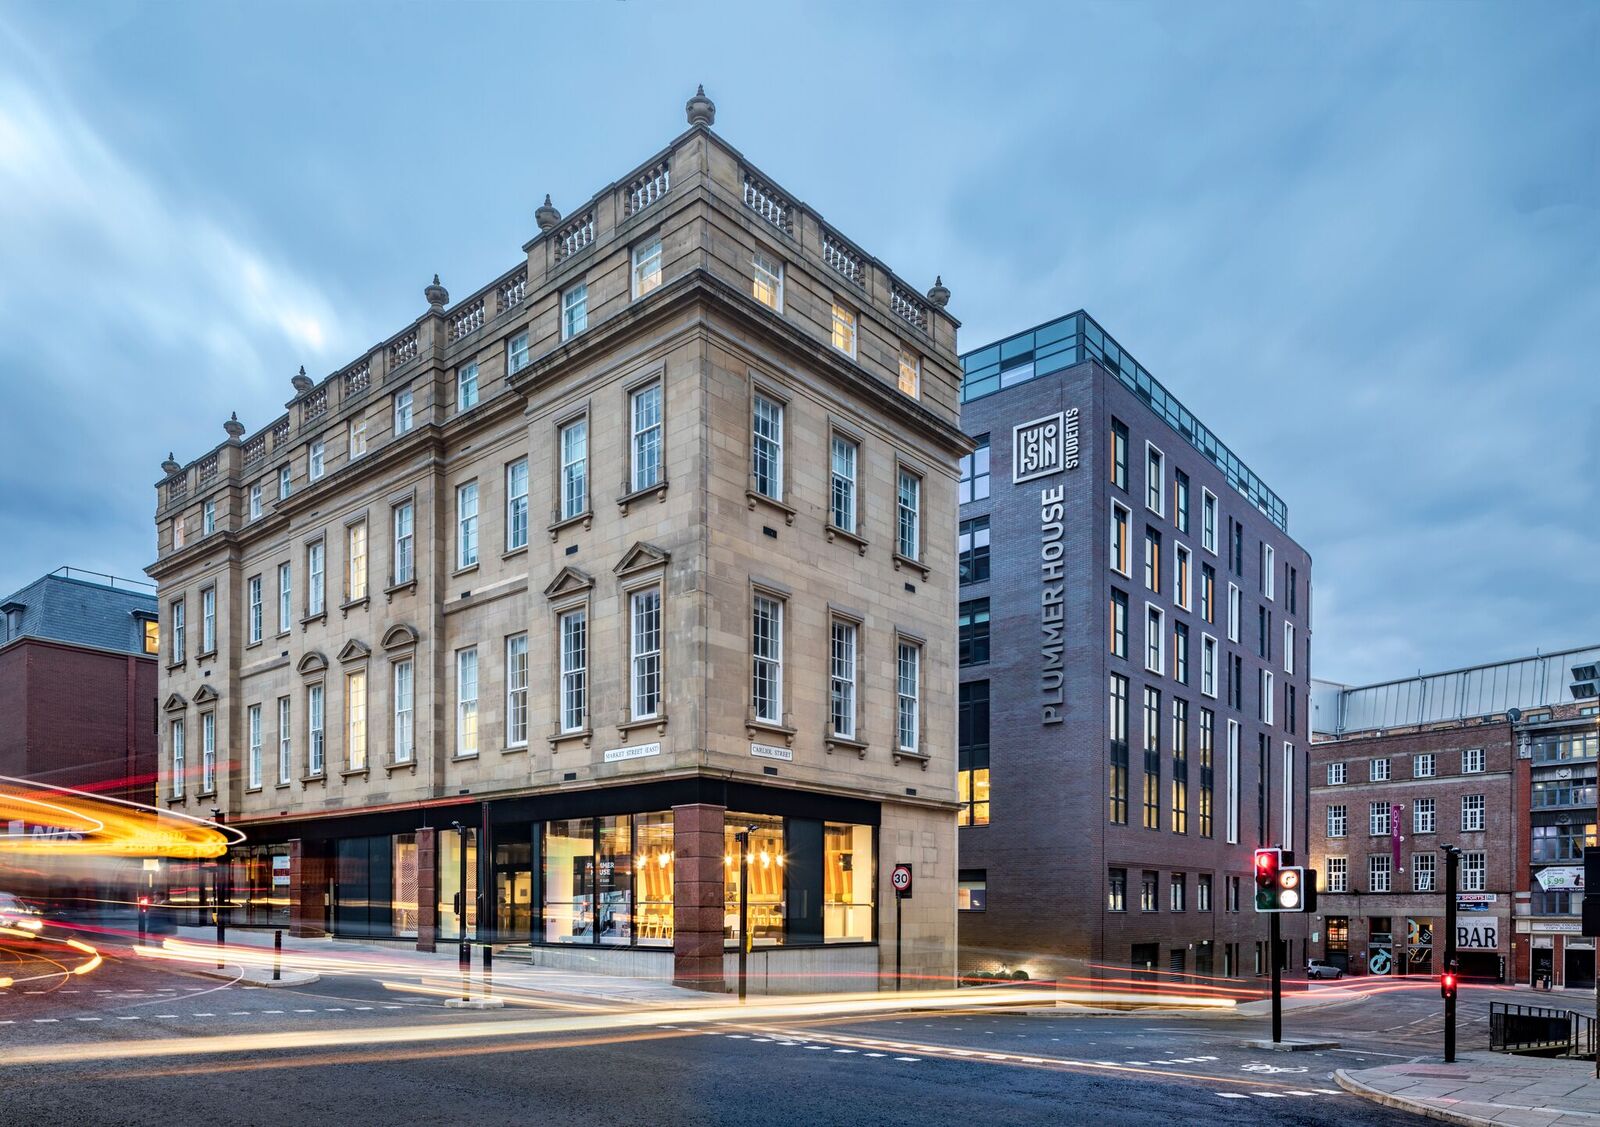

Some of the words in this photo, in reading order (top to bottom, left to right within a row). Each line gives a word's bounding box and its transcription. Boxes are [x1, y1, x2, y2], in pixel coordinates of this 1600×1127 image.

[1065, 407, 1079, 469] STUDENTS
[1042, 484, 1064, 582] HOUSE
[1042, 583, 1064, 724] PLUMMER
[626, 748, 643, 756] STREET
[774, 750, 791, 758] STREET
[895, 873, 908, 883] 30
[1457, 926, 1497, 948] BAR
